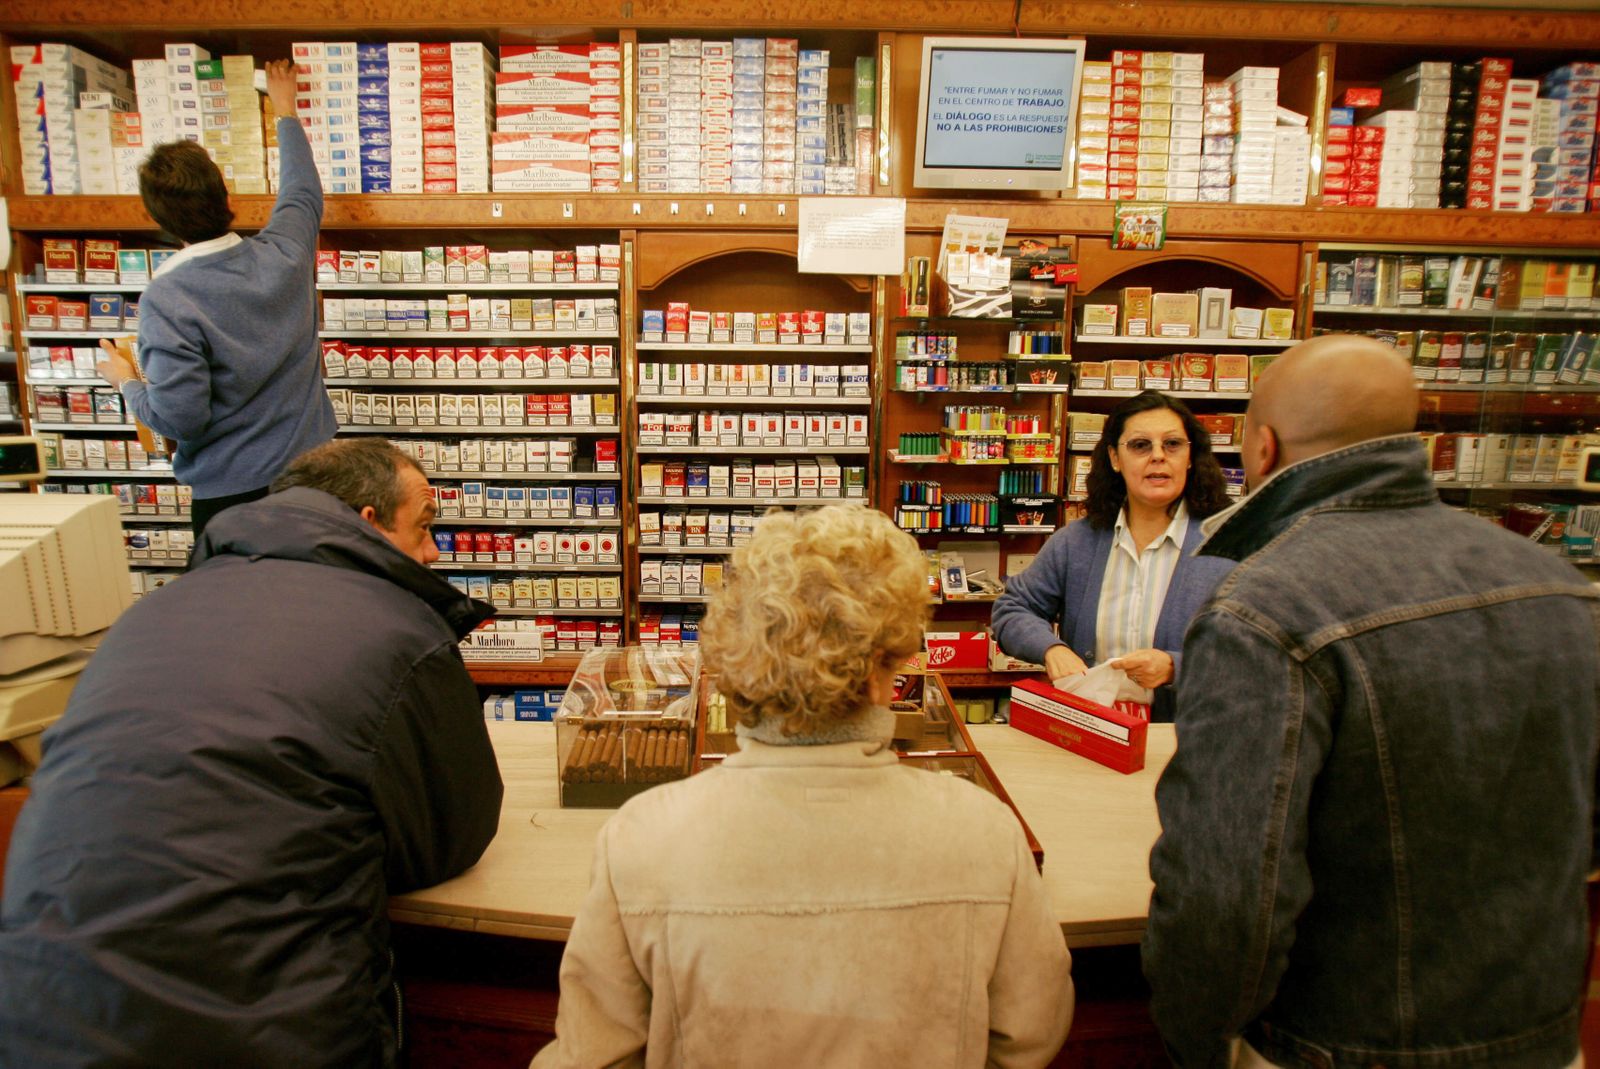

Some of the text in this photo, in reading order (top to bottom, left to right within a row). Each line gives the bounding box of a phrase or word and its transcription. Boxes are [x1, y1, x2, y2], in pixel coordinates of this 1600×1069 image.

[528, 79, 560, 87] Marlboro
[978, 86, 1008, 96] FUMAR
[1010, 87, 1016, 95] Y
[1018, 87, 1031, 96] NO
[1033, 87, 1063, 96] FUMAR
[82, 93, 100, 101] KENT
[938, 97, 951, 105] EN
[952, 97, 962, 105] EL
[964, 97, 1000, 106] CENTRO
[1002, 98, 1014, 106] DE
[527, 113, 563, 121] Marlboro
[933, 112, 944, 120] EL
[945, 111, 992, 121] DIÁLOGO
[993, 113, 1005, 121] ES
[1006, 114, 1017, 122] LA
[936, 123, 952, 131] NO
[954, 124, 961, 132] A
[963, 124, 983, 132] LAS
[523, 140, 560, 148] Marlboro
[523, 169, 560, 178] Marlboro
[477, 633, 515, 647] Marlboro
